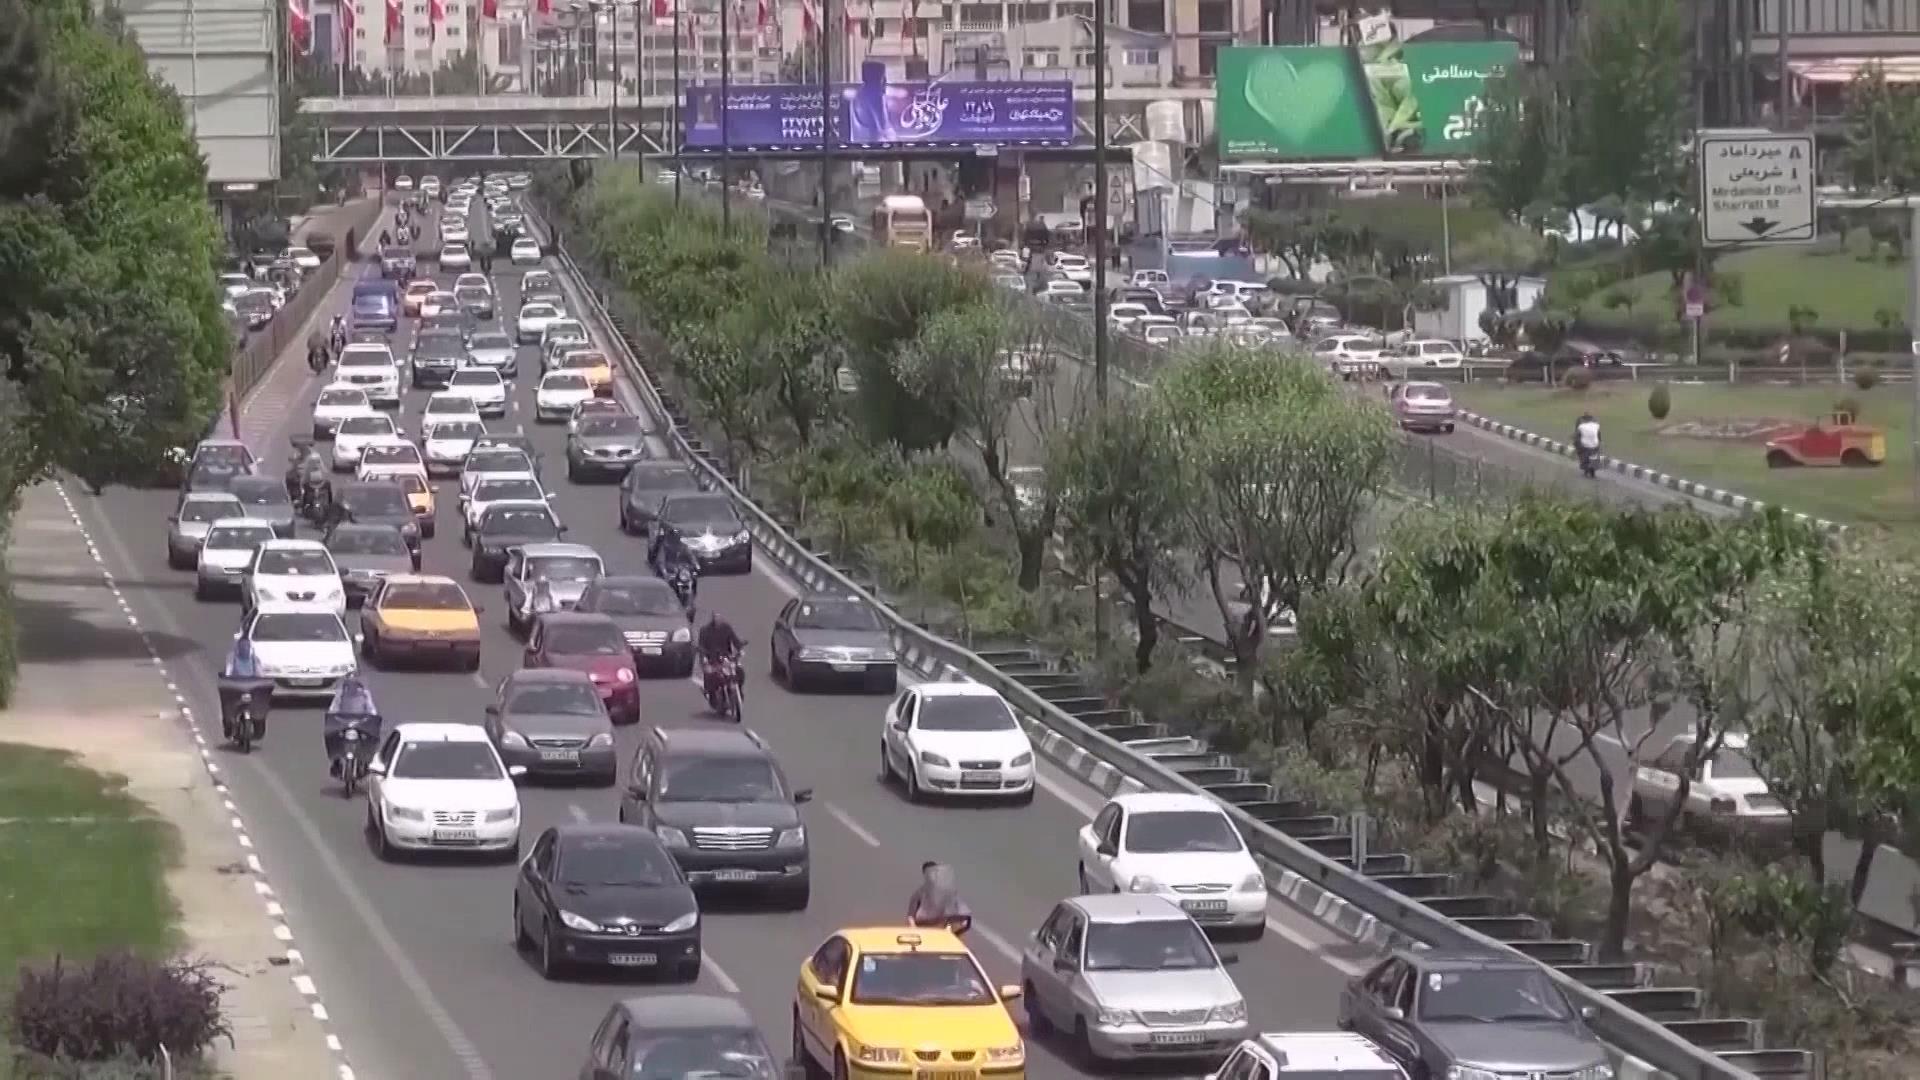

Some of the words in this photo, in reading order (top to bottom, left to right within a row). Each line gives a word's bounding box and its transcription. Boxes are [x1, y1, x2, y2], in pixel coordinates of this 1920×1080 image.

[1422, 64, 1474, 84] سلامتی
[1719, 144, 1782, 160] میرداماد
[1729, 166, 1783, 181] شریعتی
